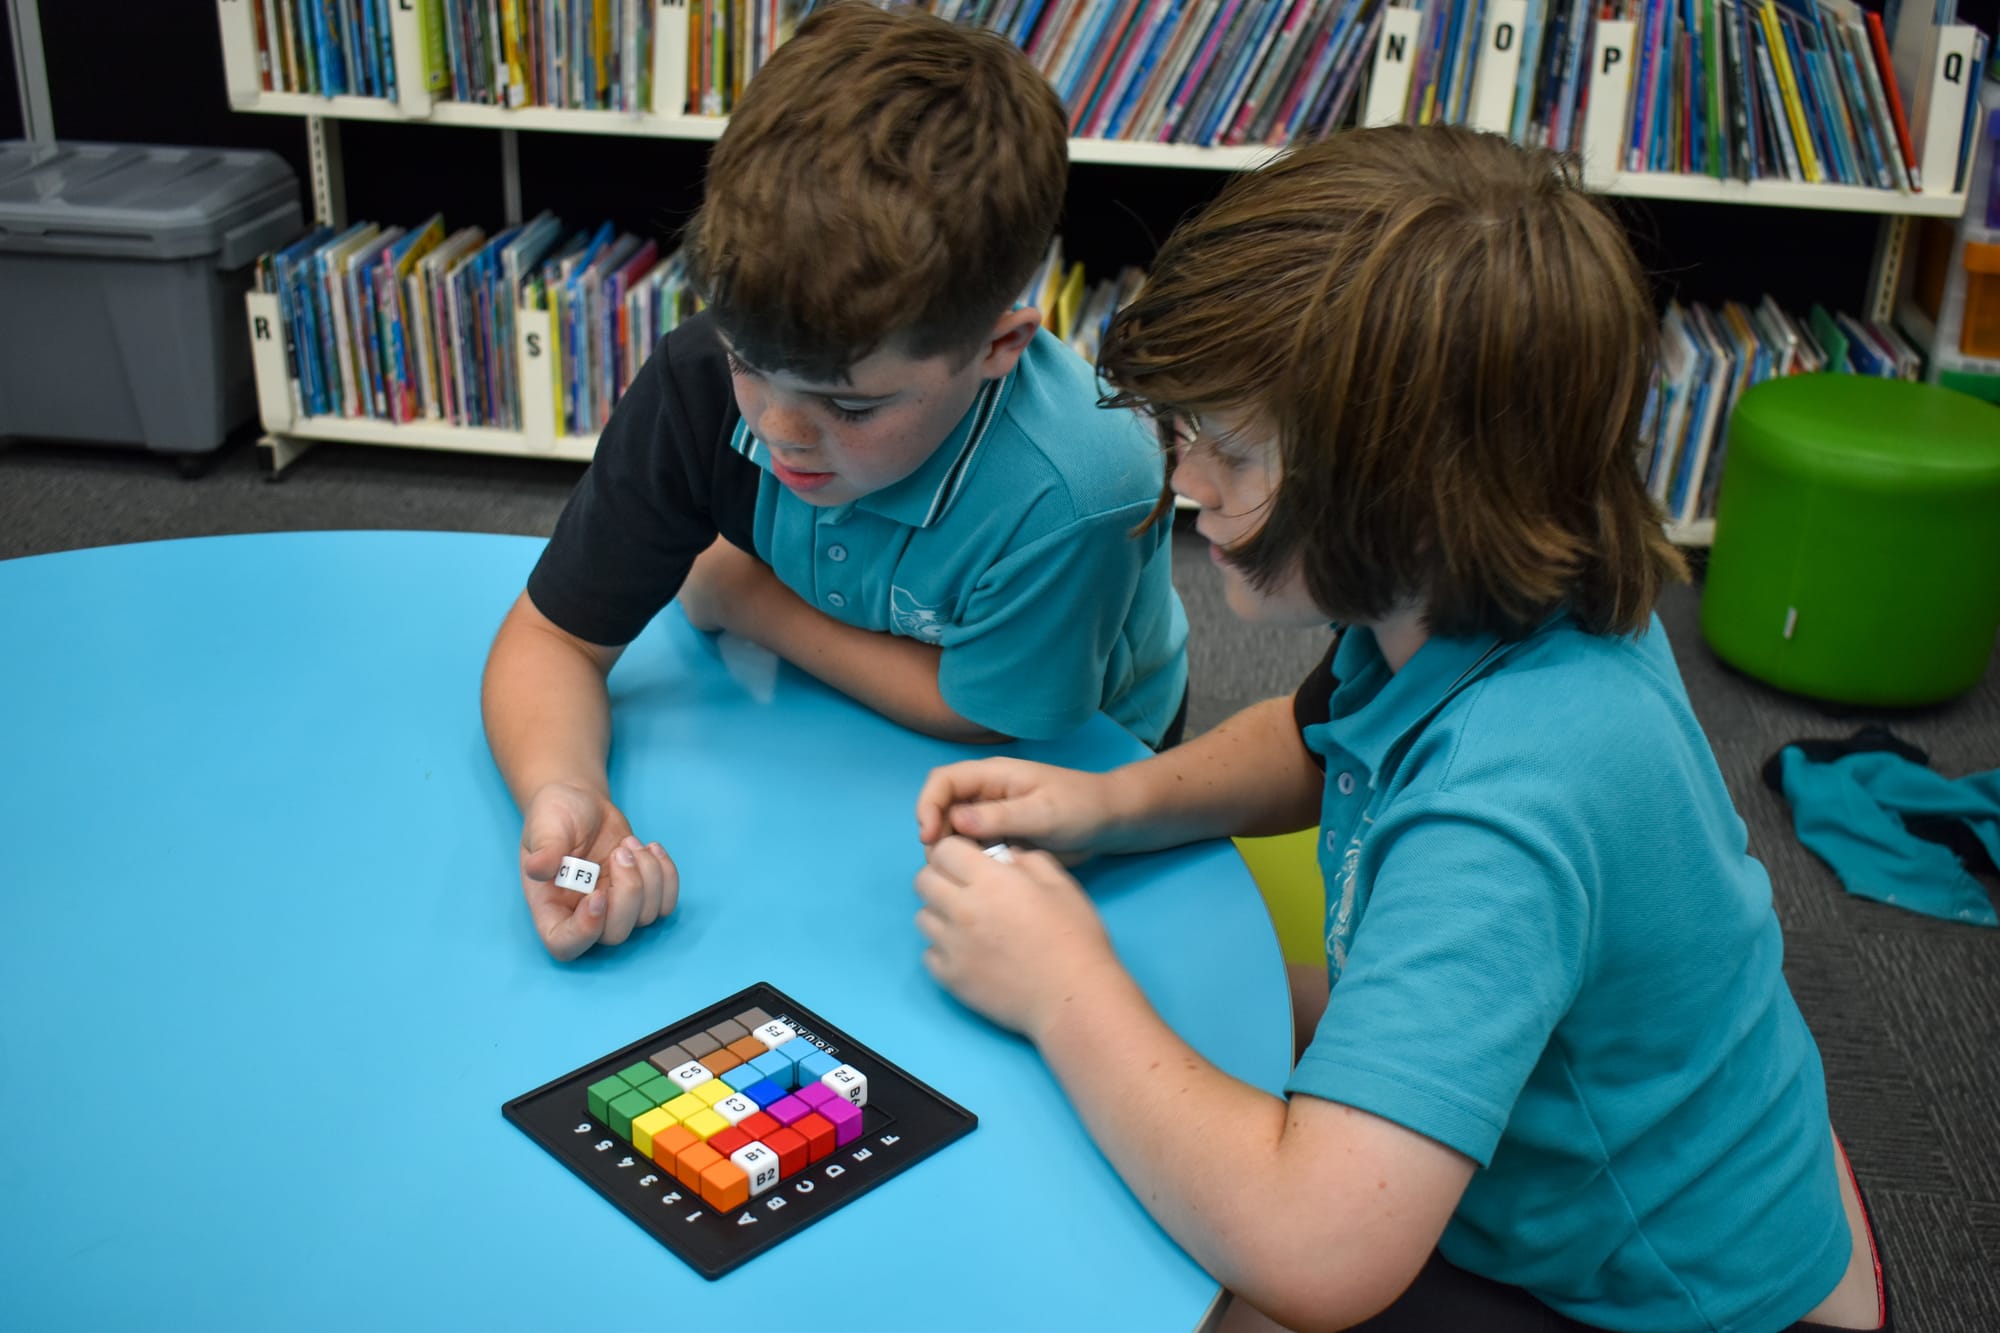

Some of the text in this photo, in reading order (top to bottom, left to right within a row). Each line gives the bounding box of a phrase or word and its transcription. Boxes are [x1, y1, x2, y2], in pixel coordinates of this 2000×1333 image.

[1494, 23, 1514, 51] O
[1386, 34, 1406, 63] N
[1602, 47, 1622, 75] P
[1944, 51, 1963, 85] Q
[255, 316, 272, 340] R
[526, 333, 541, 357] S
[575, 869, 593, 884] F3
[765, 1025, 785, 1038] F5
[680, 1066, 702, 1079] C5
[834, 1070, 855, 1083] F2
[725, 1098, 746, 1112] C3
[595, 1140, 613, 1151] 5
[745, 1148, 767, 1161] B1
[617, 1157, 635, 1168] 4
[639, 1174, 658, 1186] 3
[737, 1134, 900, 1225] A B C D E F
[756, 1168, 775, 1186] B2
[662, 1191, 682, 1204] 2
[685, 1211, 703, 1222] 1
